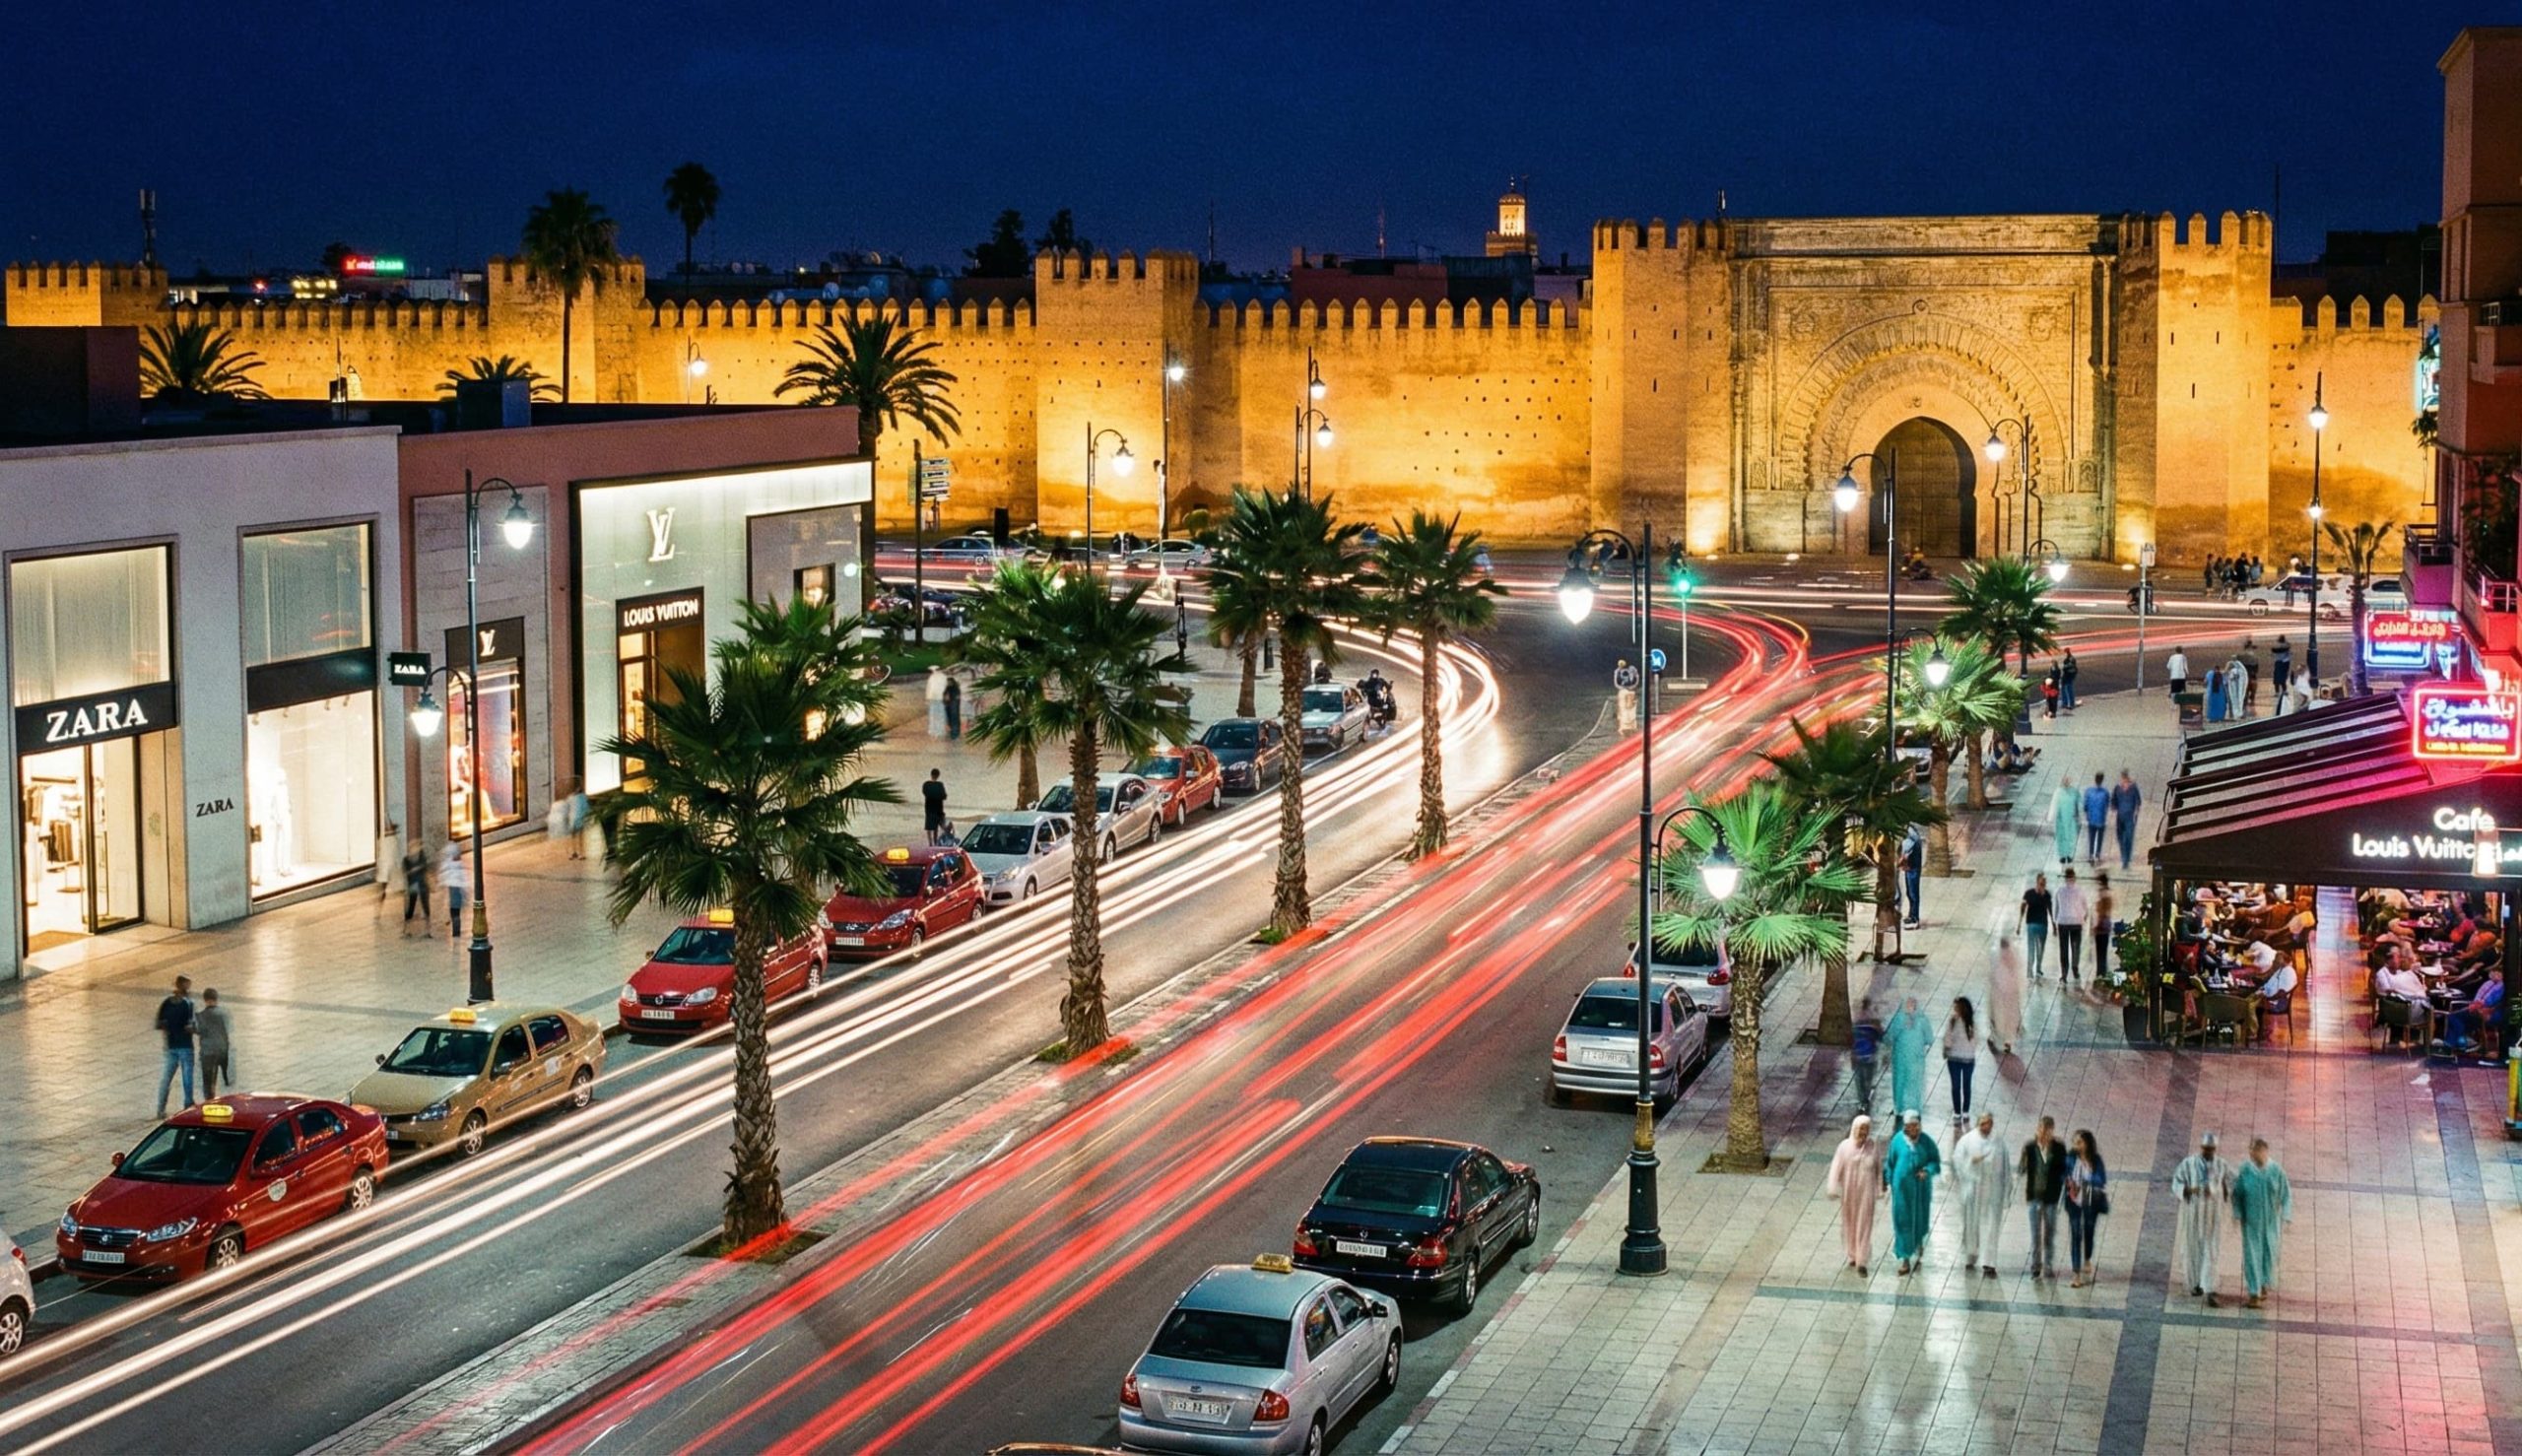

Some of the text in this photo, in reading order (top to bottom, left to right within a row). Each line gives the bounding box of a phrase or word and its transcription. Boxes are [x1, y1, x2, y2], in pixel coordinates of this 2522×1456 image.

[624, 598, 698, 628] LOUIS VUITTON
[46, 698, 148, 743] ZARA
[196, 798, 234, 818] ZARA
[2433, 807, 2496, 832] Cafe
[2352, 832, 2411, 858] Louis
